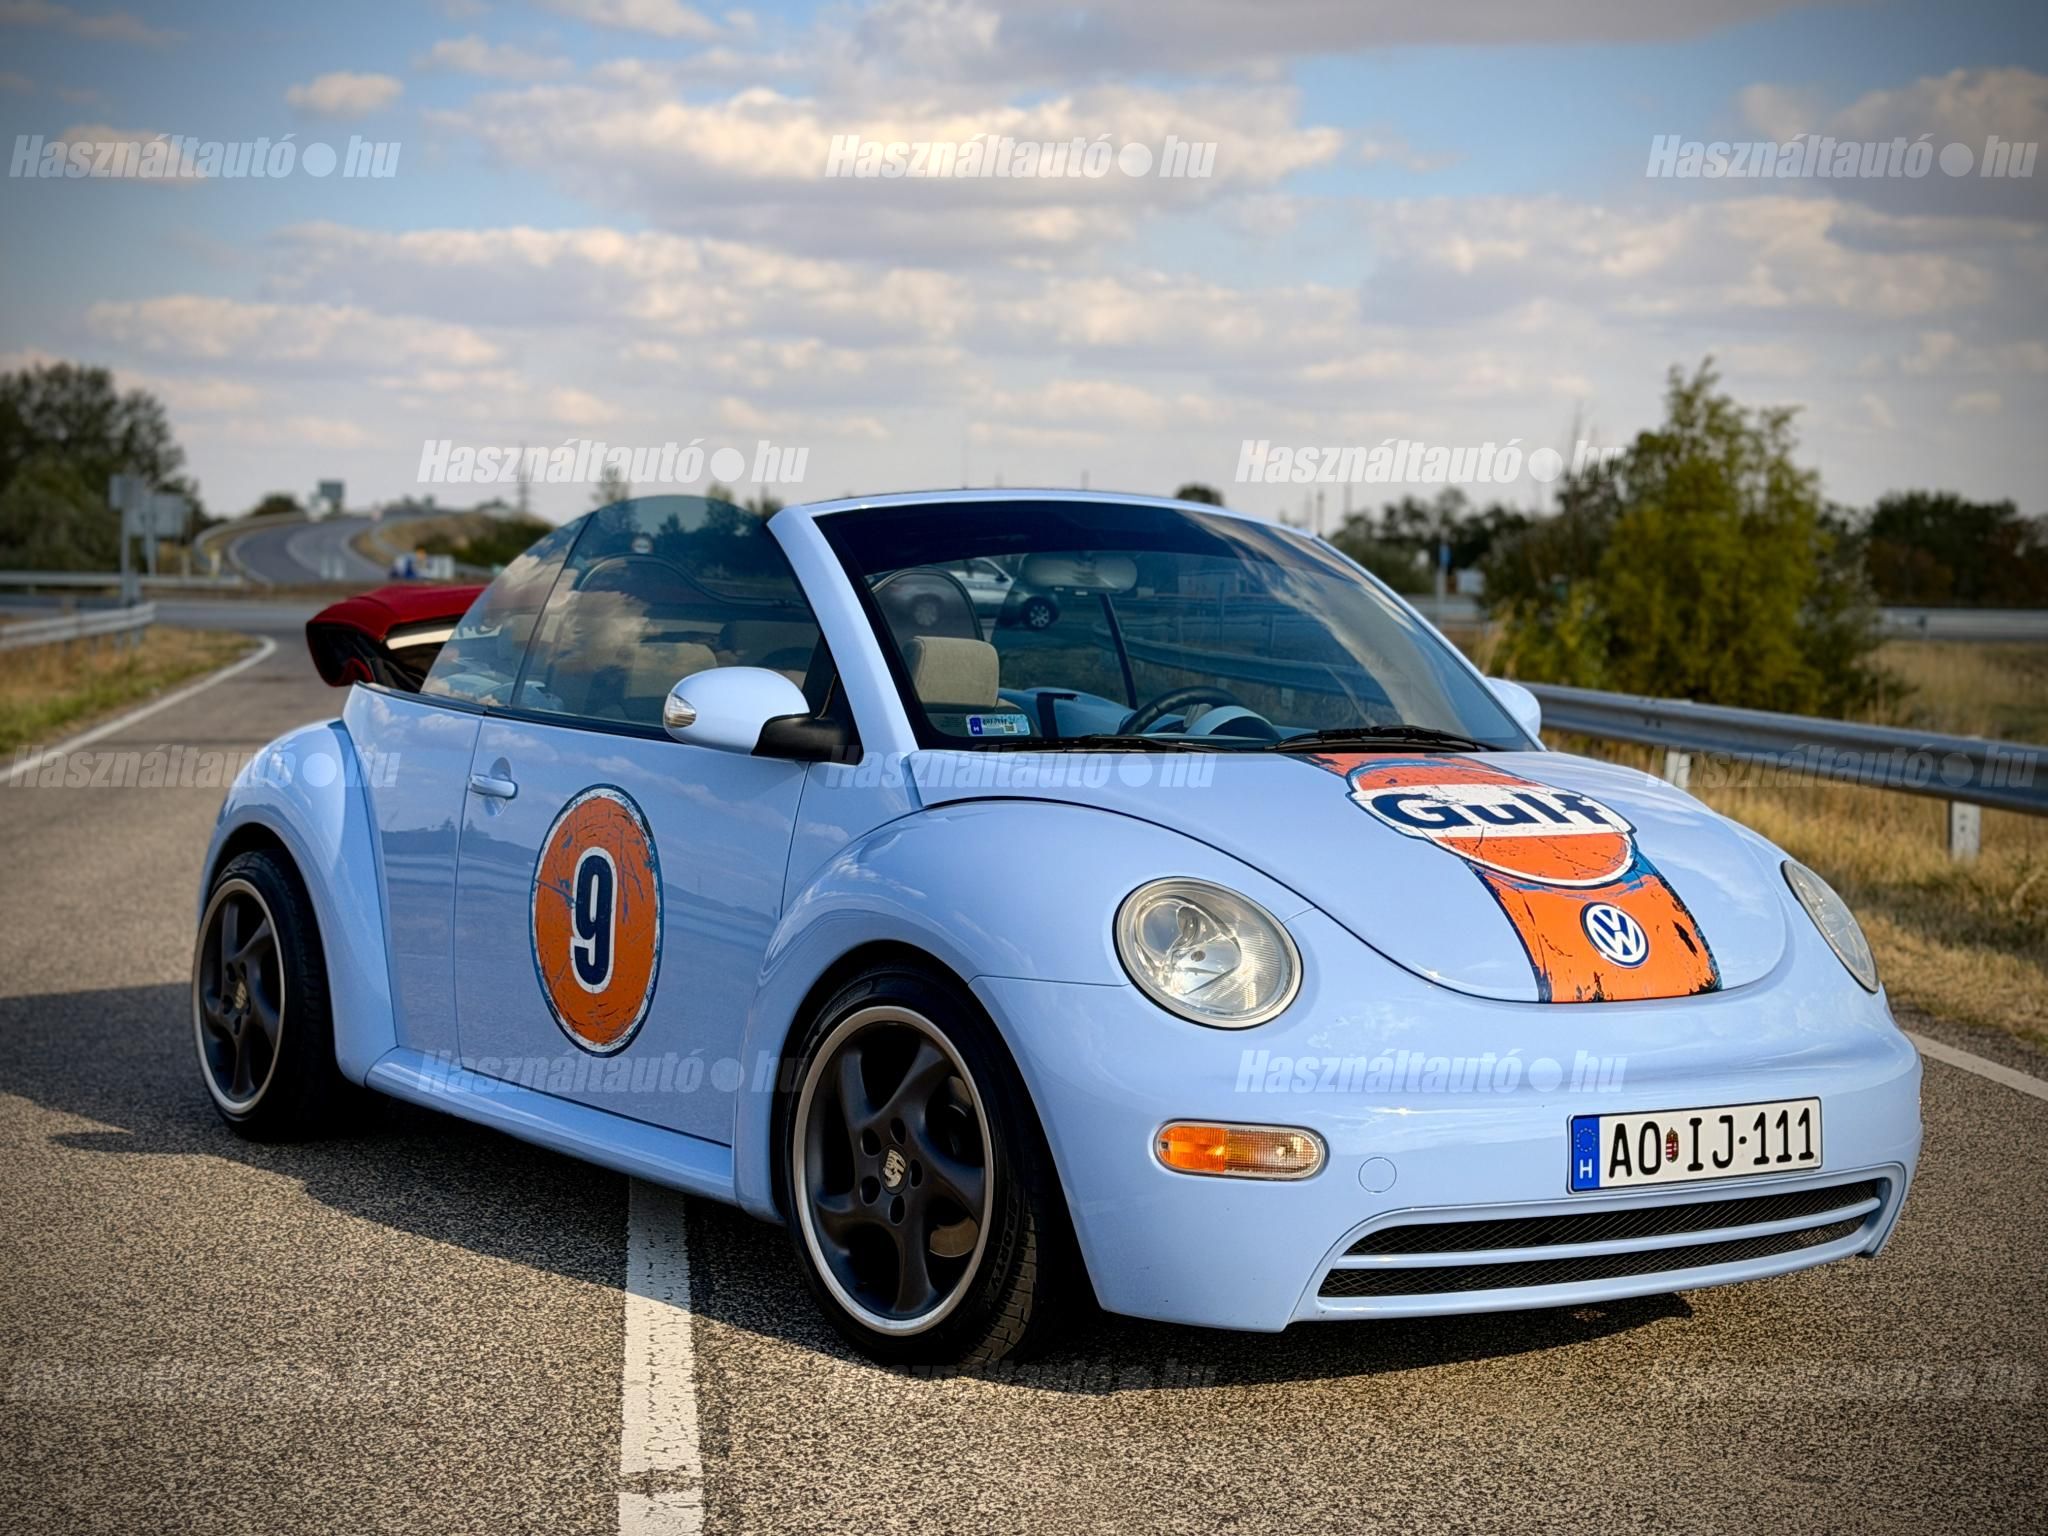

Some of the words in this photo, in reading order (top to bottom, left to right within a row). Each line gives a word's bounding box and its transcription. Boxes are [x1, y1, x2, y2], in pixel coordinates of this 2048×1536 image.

[1371, 791, 1609, 830] Gulf
[572, 851, 616, 990] 9
[1581, 902, 1649, 967] VW
[1579, 1158, 1593, 1179] H
[1608, 1121, 1662, 1178] AO
